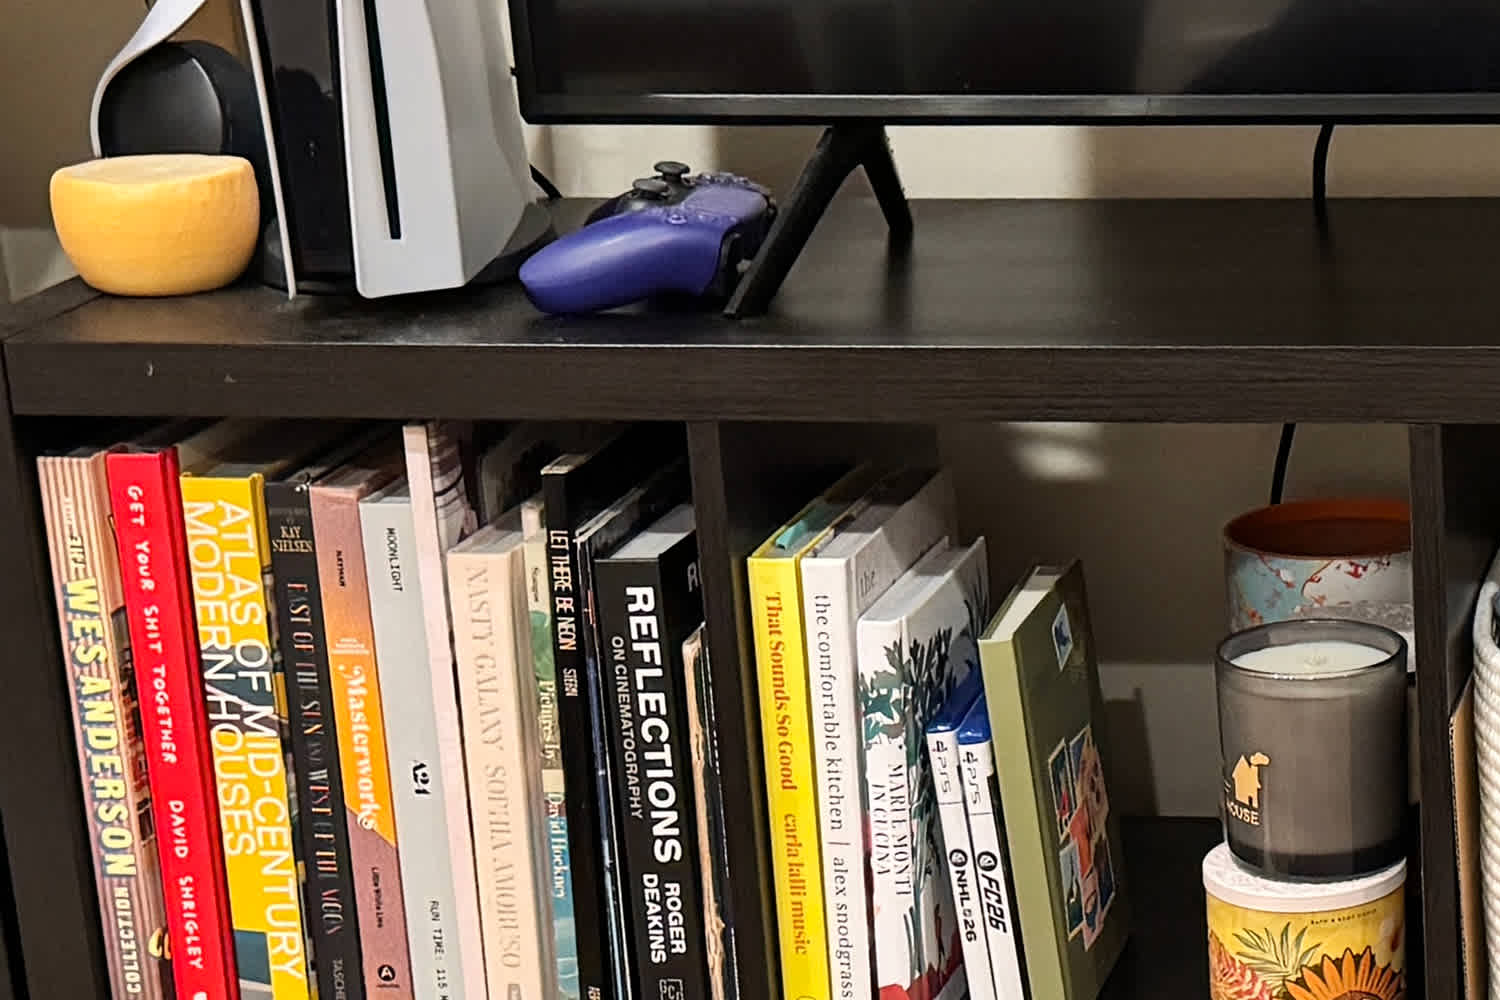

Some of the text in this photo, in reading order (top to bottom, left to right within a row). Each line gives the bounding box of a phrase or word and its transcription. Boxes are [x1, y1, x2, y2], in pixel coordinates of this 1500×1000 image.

[272, 540, 314, 553] NIELSEN
[280, 526, 302, 539] KAY
[387, 527, 404, 592] MOONLIGHT
[127, 485, 177, 765] GET YOUR SHIT TOGETHER
[550, 529, 578, 651] LET THERE BE NEON
[183, 500, 256, 857] MODERN HOUSES
[466, 566, 504, 752] NASTY GALAXY
[538, 680, 557, 742] Pictures
[563, 667, 579, 697] STERN
[765, 590, 798, 791] That Sounds So Good
[815, 594, 845, 831] the comfortable kitchen
[64, 578, 137, 878] WES ANDERSON
[217, 500, 305, 980] ATLAS OF MID-CENTURY
[292, 631, 315, 653] OF
[308, 768, 333, 817] WEST
[338, 663, 383, 831] Masterworks
[411, 759, 432, 795] A24
[611, 635, 644, 820] ON CINEMATOGRAPHY
[625, 585, 683, 863] REFLECTIONS
[936, 755, 952, 794] PS5
[485, 764, 513, 856] SOPHIA
[871, 783, 887, 801] IN
[965, 766, 981, 805] PS5
[168, 800, 204, 969] DAVID SHRIGLEY
[546, 791, 571, 899] David Hockney
[783, 812, 811, 955] carla lalli music
[894, 834, 912, 895] MONTI
[113, 886, 142, 993] COLLECTION
[430, 899, 441, 922] RUN
[433, 928, 445, 961] TIME:
[493, 858, 522, 969] AMORUSO
[642, 873, 667, 964] DEAKINS
[664, 882, 688, 955] ROGER
[833, 856, 854, 999] alex snodgrass
[955, 869, 978, 943] NHL 26
[437, 968, 448, 991] 115
